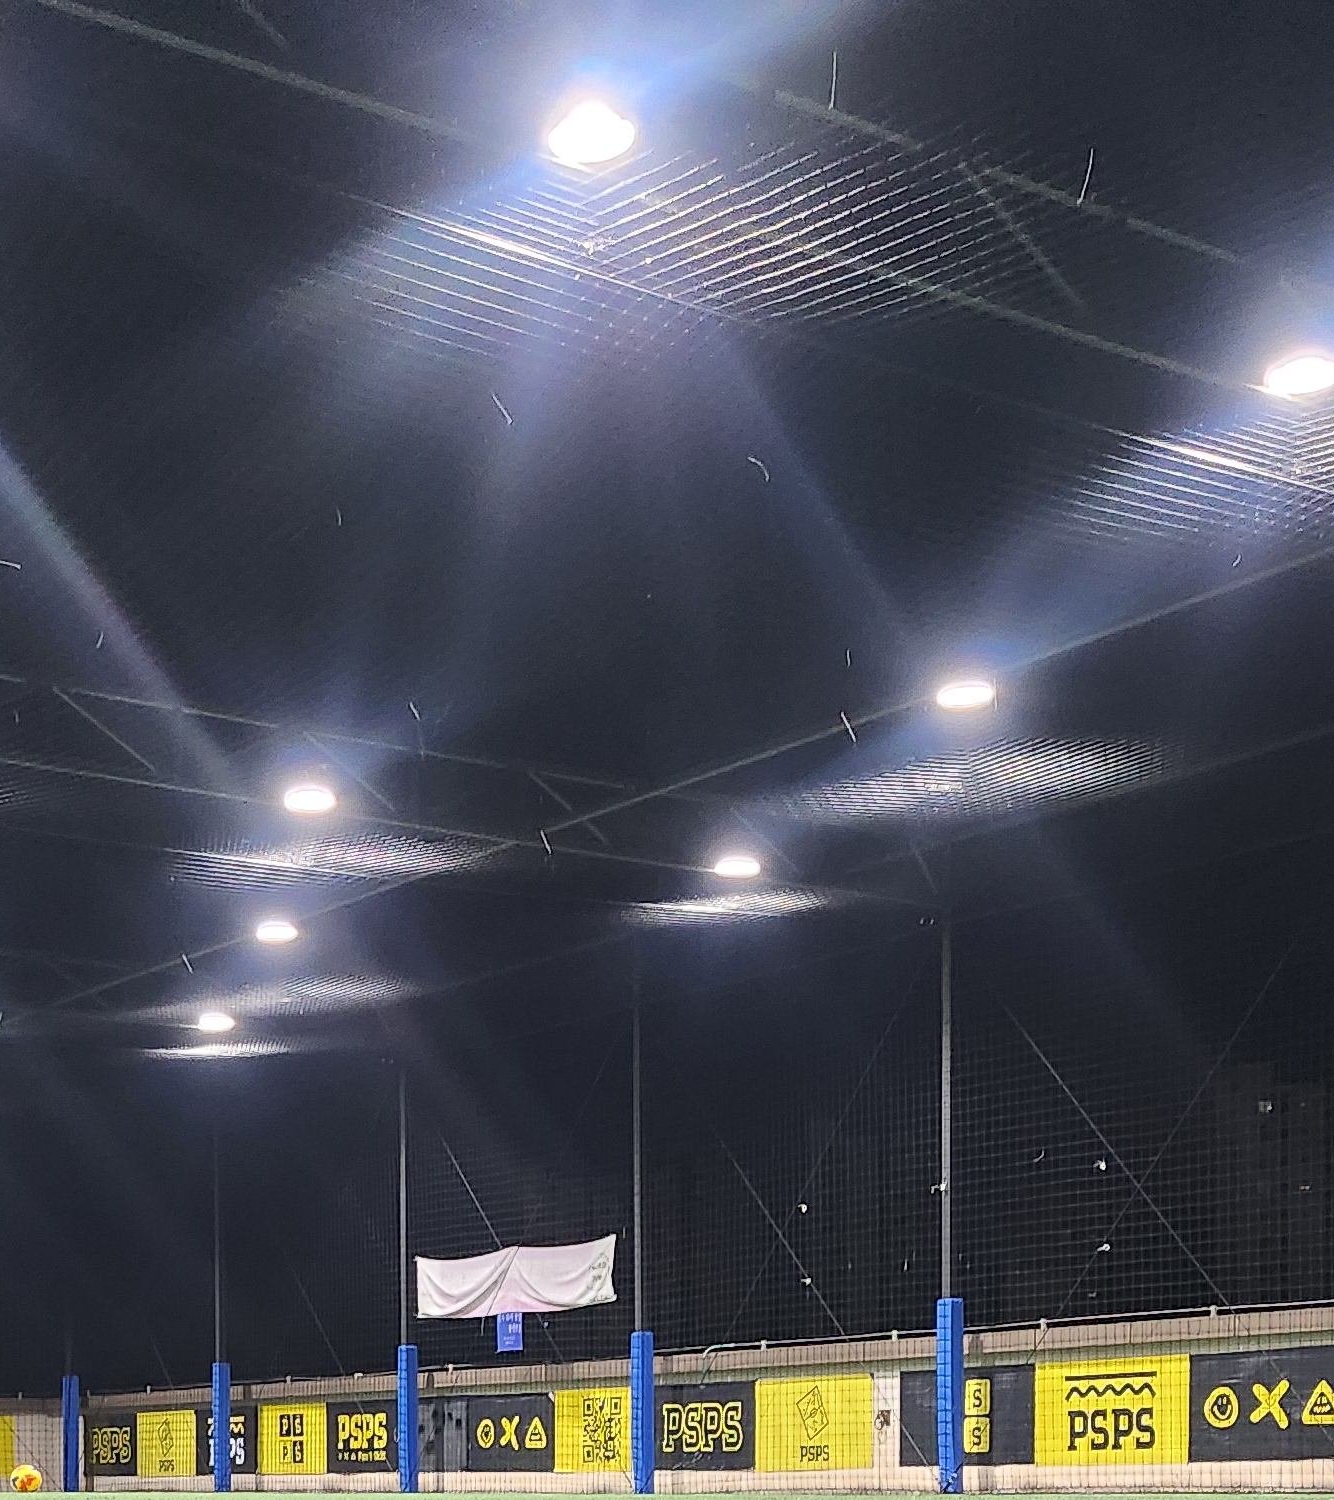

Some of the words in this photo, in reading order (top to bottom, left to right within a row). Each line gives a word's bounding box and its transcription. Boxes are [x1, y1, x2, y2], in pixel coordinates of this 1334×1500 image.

[92, 1426, 132, 1464] PSPS
[337, 1412, 387, 1450] PSPS
[662, 1401, 744, 1453] PSPS
[1068, 1407, 1156, 1451] PSPS
[800, 1445, 831, 1462] PSPS
